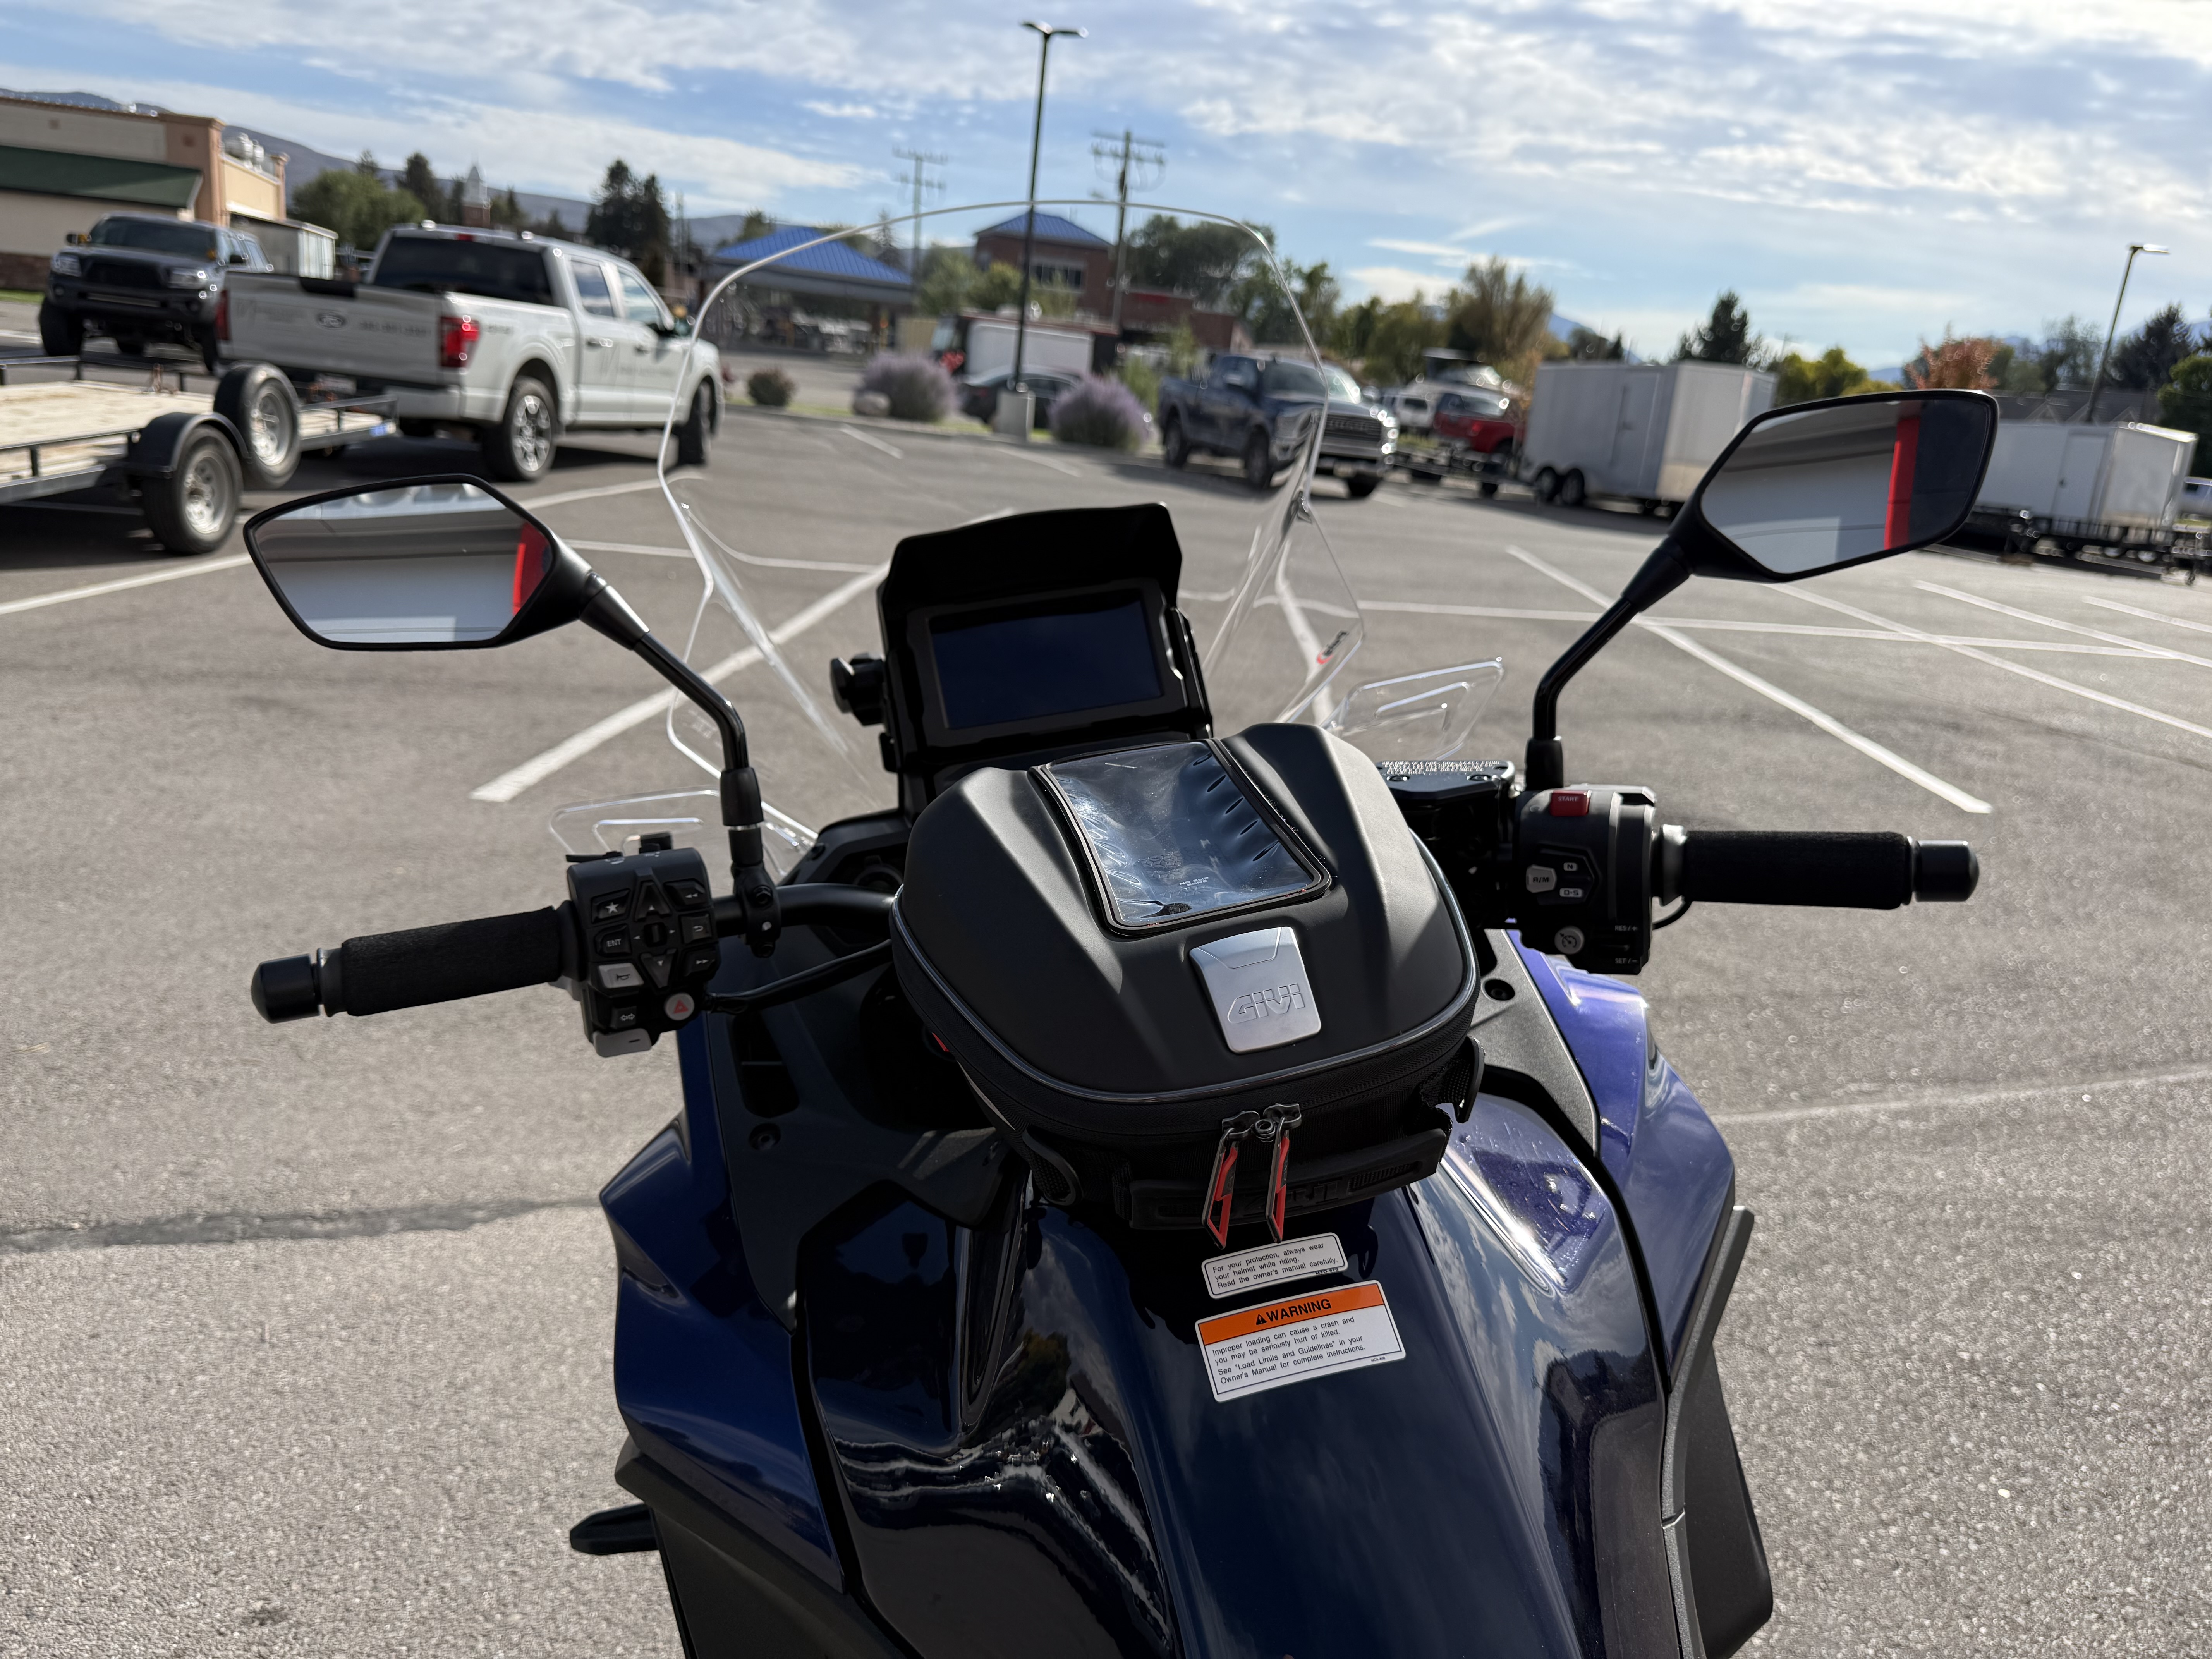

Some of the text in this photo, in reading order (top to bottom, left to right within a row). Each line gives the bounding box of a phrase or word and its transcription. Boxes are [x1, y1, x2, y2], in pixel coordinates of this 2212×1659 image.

[607, 938, 622, 947] ENT
[1227, 983, 1306, 1024] GIVI
[1215, 1273, 1229, 1282] your
[1233, 1266, 1255, 1276] helmet
[1218, 1279, 1235, 1289] Read
[1253, 1269, 1278, 1279] owner's
[1282, 1262, 1306, 1273] manual
[1310, 1257, 1338, 1267] carefully.
[1228, 1261, 1241, 1271] your
[1245, 1253, 1279, 1266] protection,
[1283, 1247, 1305, 1255] always
[1266, 1299, 1331, 1322] WARNING
[1212, 1343, 1242, 1356] Improper
[1246, 1336, 1270, 1347] loading
[1290, 1327, 1309, 1335] cause
[1321, 1320, 1339, 1328] crash
[1215, 1357, 1228, 1366] you
[1231, 1352, 1245, 1360] may
[1261, 1340, 1290, 1352] seriously
[1293, 1336, 1307, 1344] hurt
[1321, 1329, 1340, 1338] killed.
[1258, 1355, 1278, 1364] Limits
[1282, 1350, 1295, 1358] and
[1348, 1336, 1362, 1345] your
[1221, 1372, 1248, 1384] Owner's
[1252, 1364, 1276, 1376] Manual
[1293, 1354, 1323, 1365] complete
[1326, 1345, 1365, 1357] instructions.
